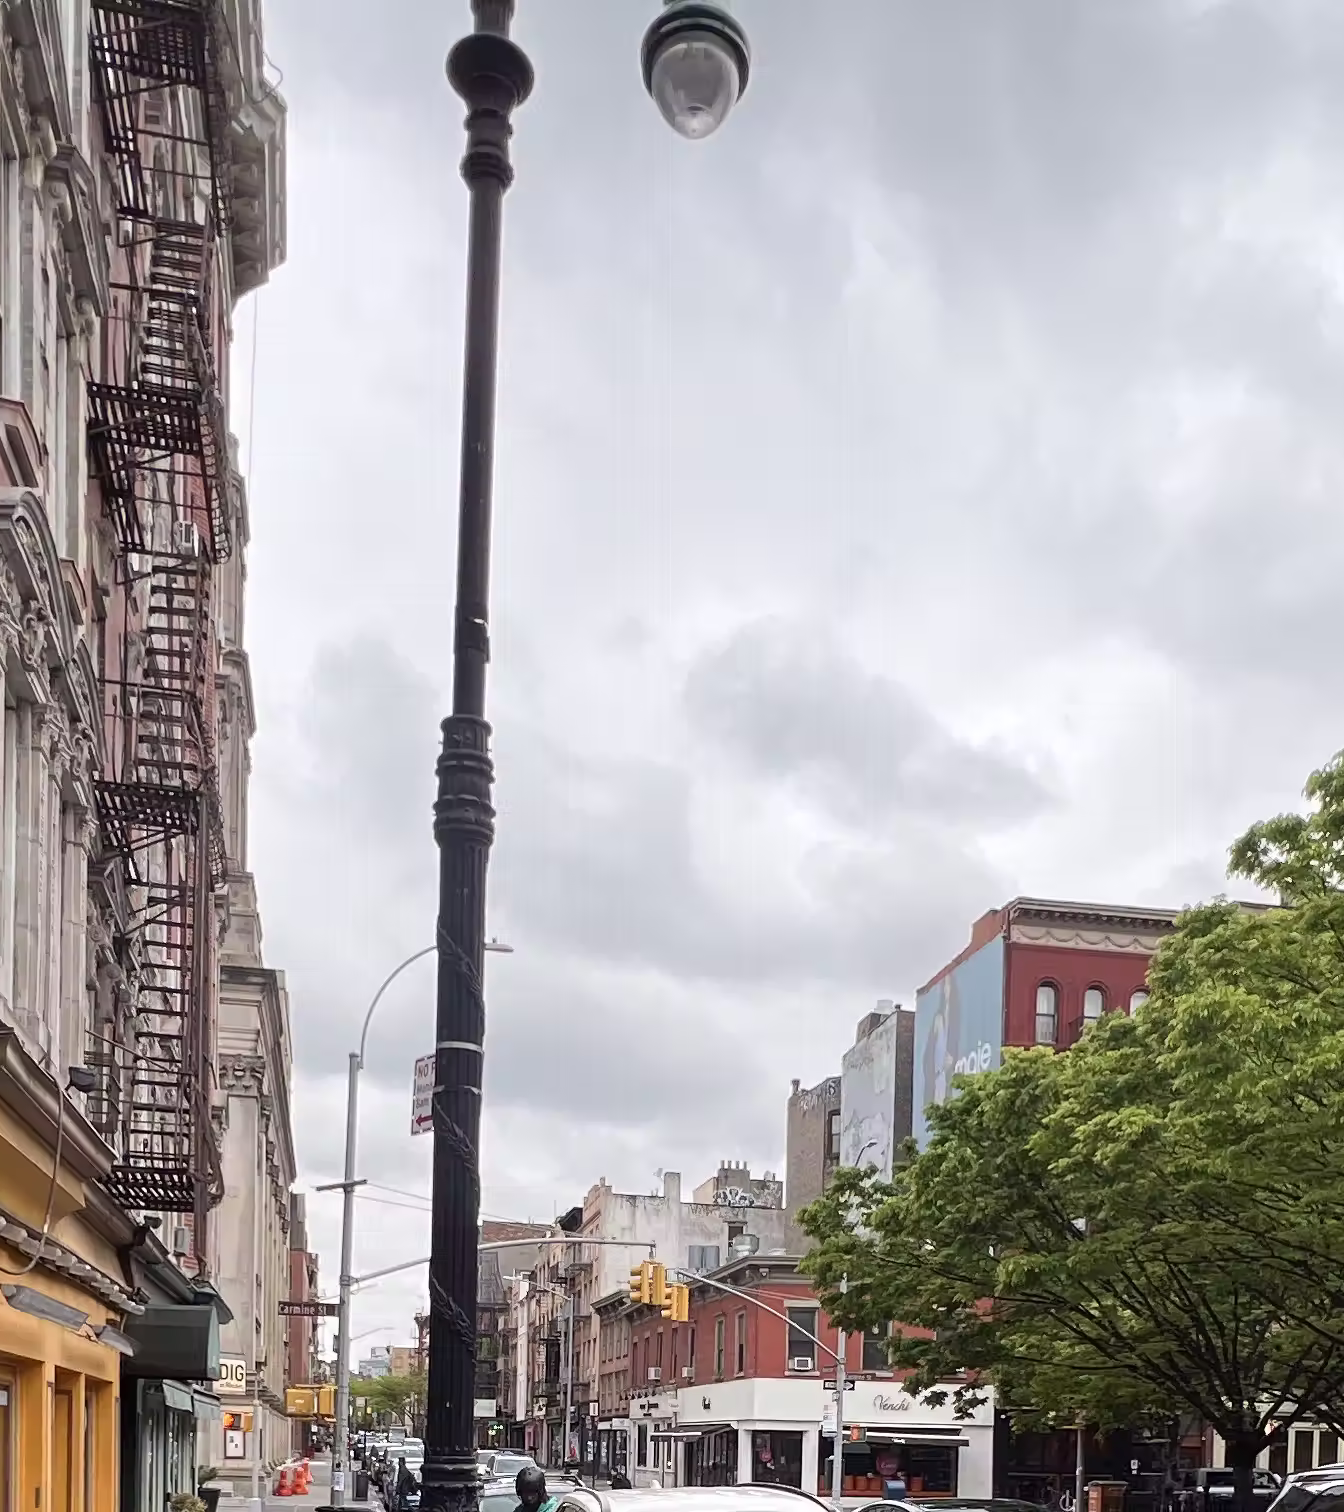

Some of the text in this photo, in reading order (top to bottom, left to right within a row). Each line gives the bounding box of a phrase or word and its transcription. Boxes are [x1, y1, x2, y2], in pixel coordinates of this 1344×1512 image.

[278, 1303, 327, 1315] Carmine St
[219, 1363, 244, 1382] DIG
[873, 1394, 912, 1415] Venchi
